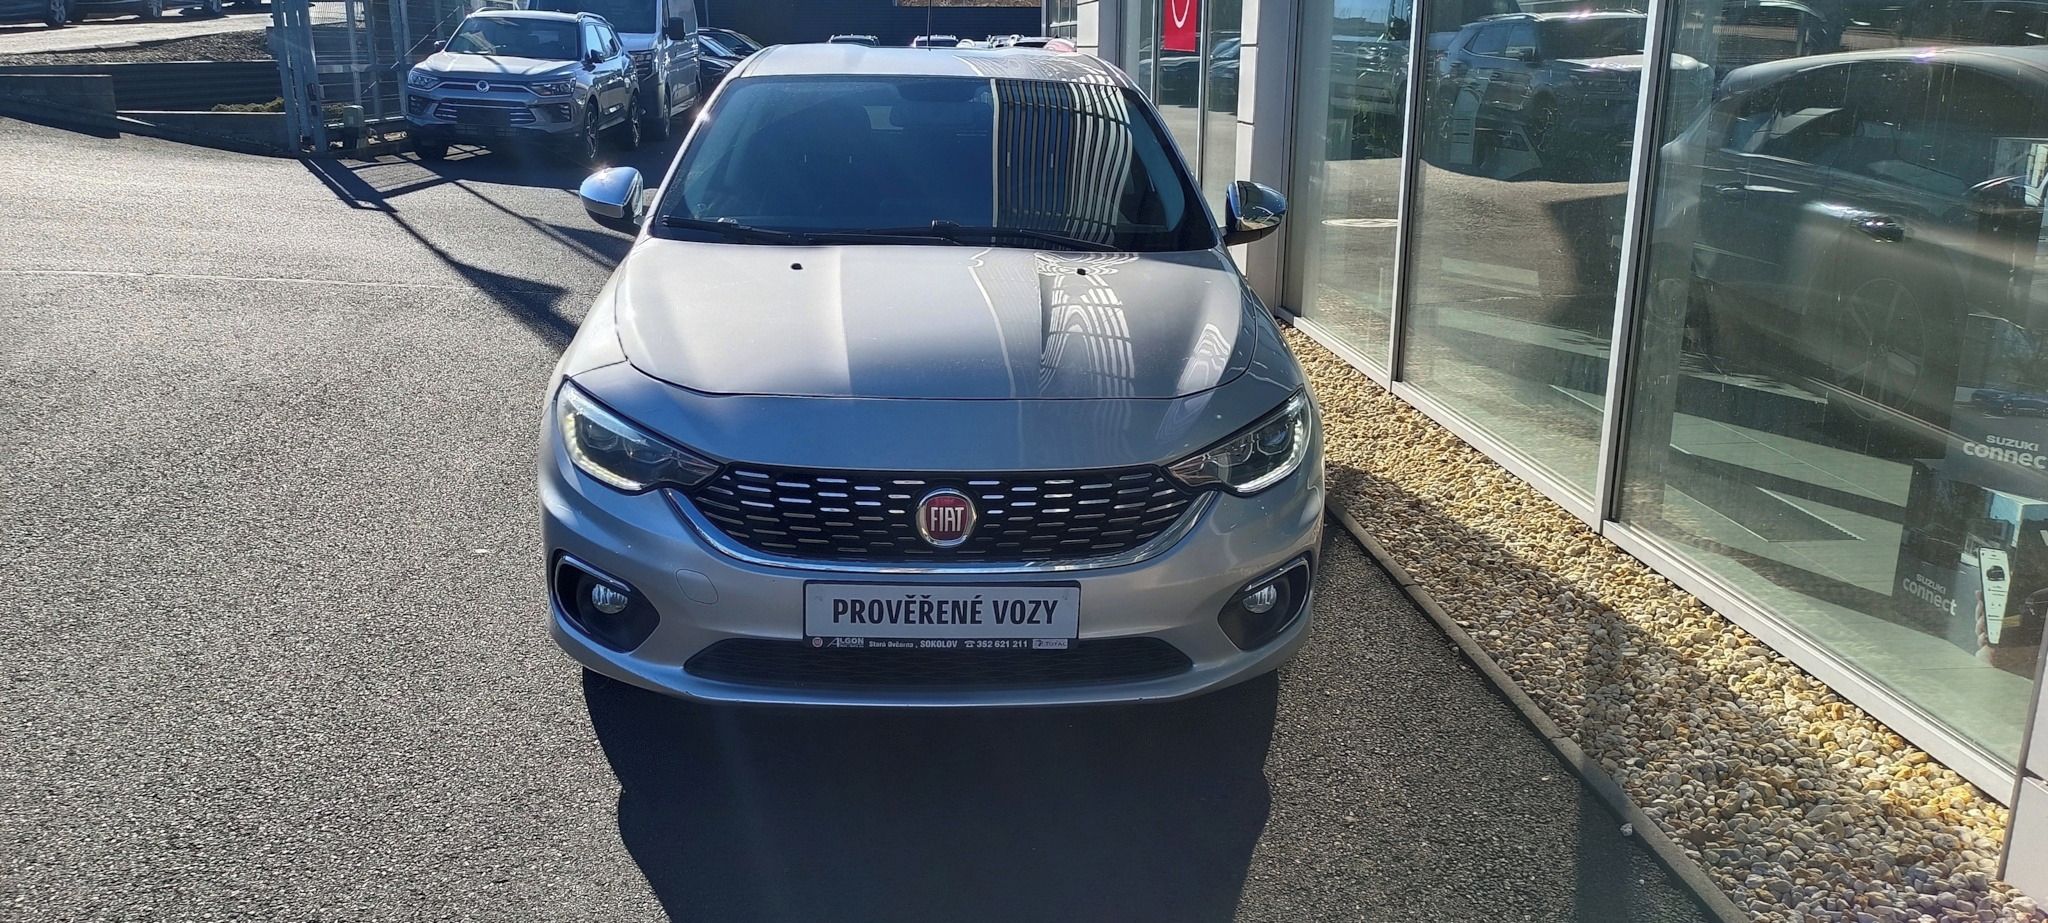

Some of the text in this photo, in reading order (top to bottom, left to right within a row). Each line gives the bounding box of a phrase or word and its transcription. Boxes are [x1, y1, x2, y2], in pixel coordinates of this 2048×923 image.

[1986, 435, 2039, 451] SUZUKI
[931, 507, 964, 532] FIAT
[1903, 578, 1957, 616] connect
[832, 594, 1059, 625] PROVĚŘENÉ VOZY
[827, 637, 864, 648] ALGON
[920, 640, 958, 648] SOKOLOV
[976, 640, 993, 648] 352
[994, 640, 1010, 648] 621
[1012, 640, 1028, 648] 211
